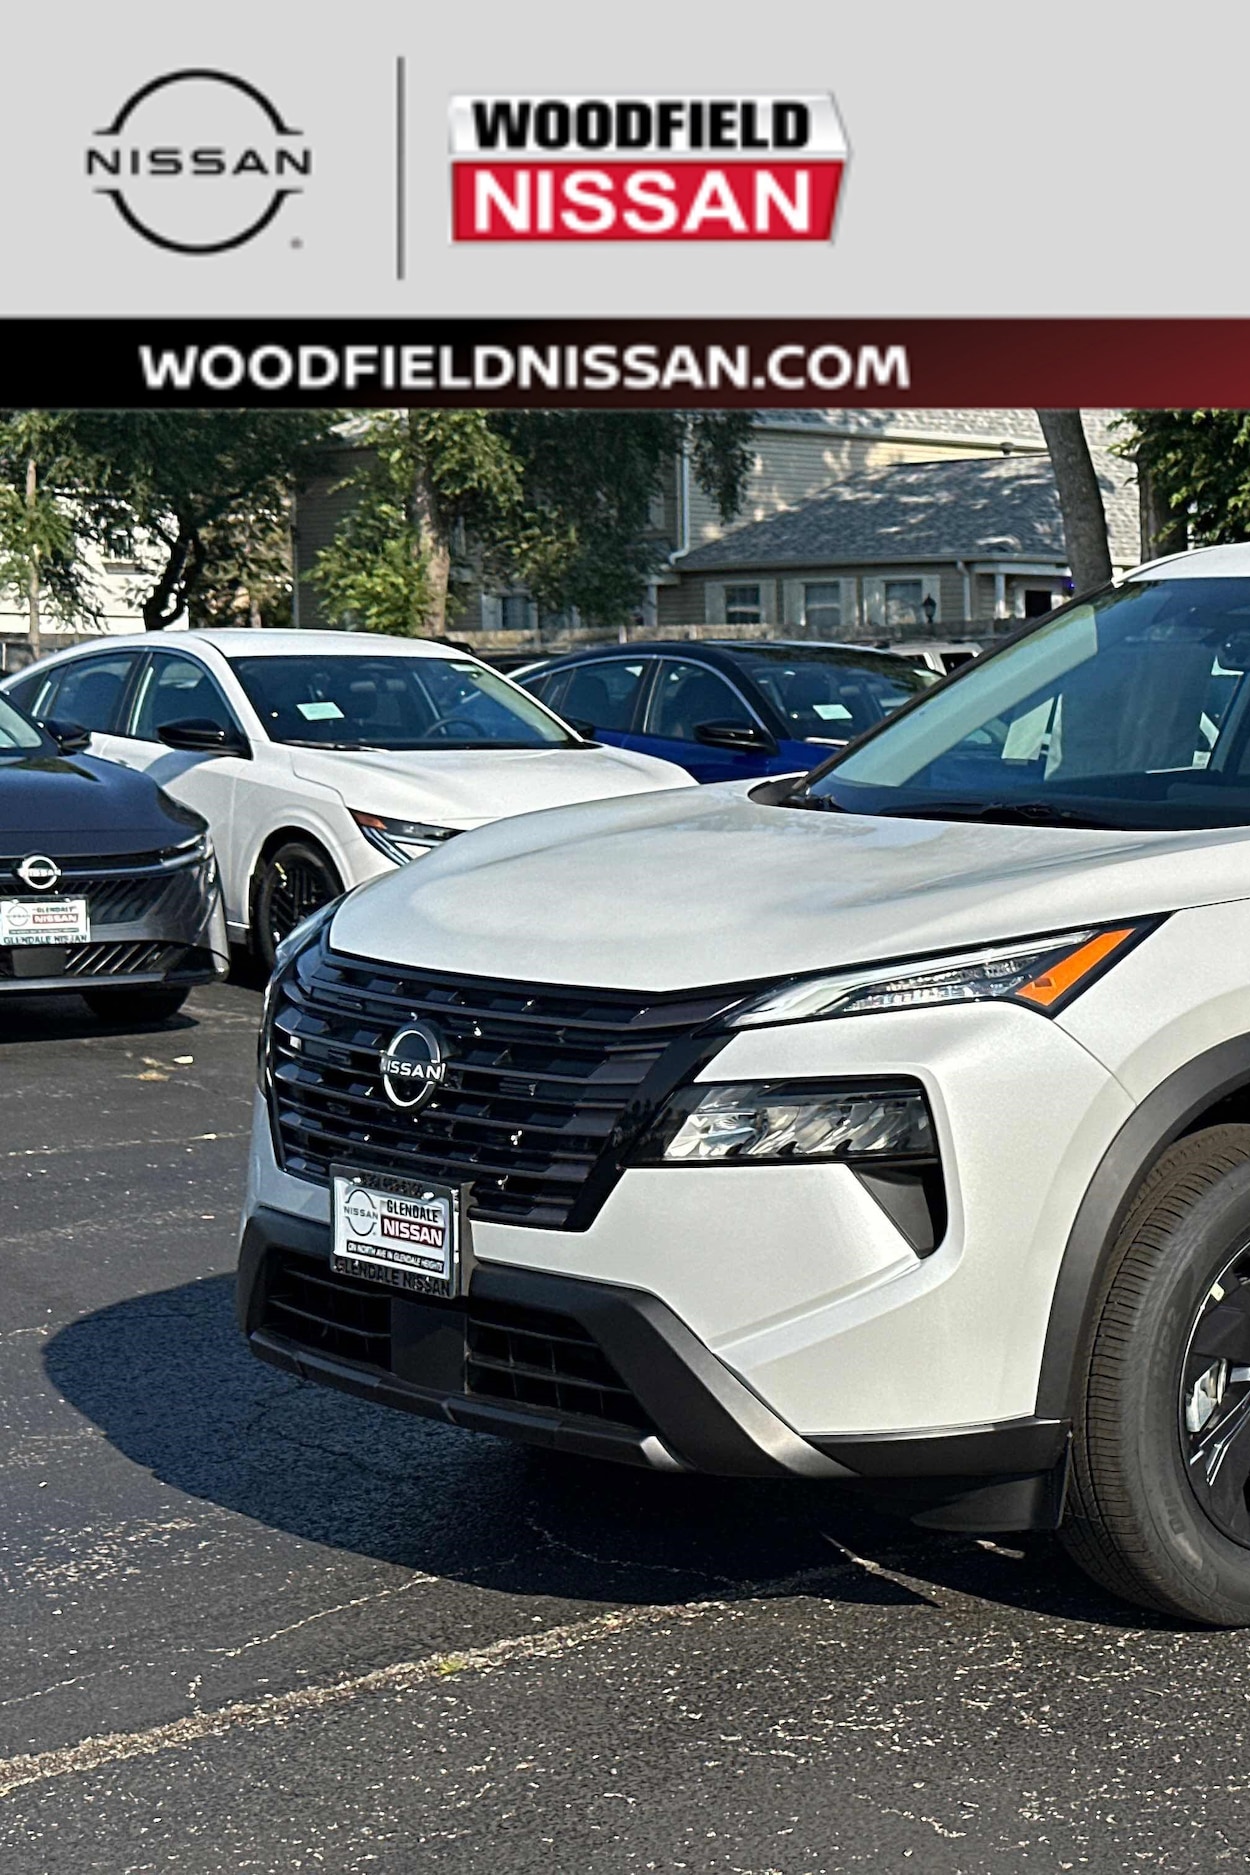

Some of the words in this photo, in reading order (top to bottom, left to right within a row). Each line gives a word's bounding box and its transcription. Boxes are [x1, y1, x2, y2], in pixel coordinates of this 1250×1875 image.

[344, 1205, 379, 1220] NISSAN
[386, 1199, 439, 1223] GLENDALE
[383, 1218, 443, 1247] NISSAN
[335, 1258, 400, 1285] GLENDALE
[402, 1270, 451, 1297] NISSAN
